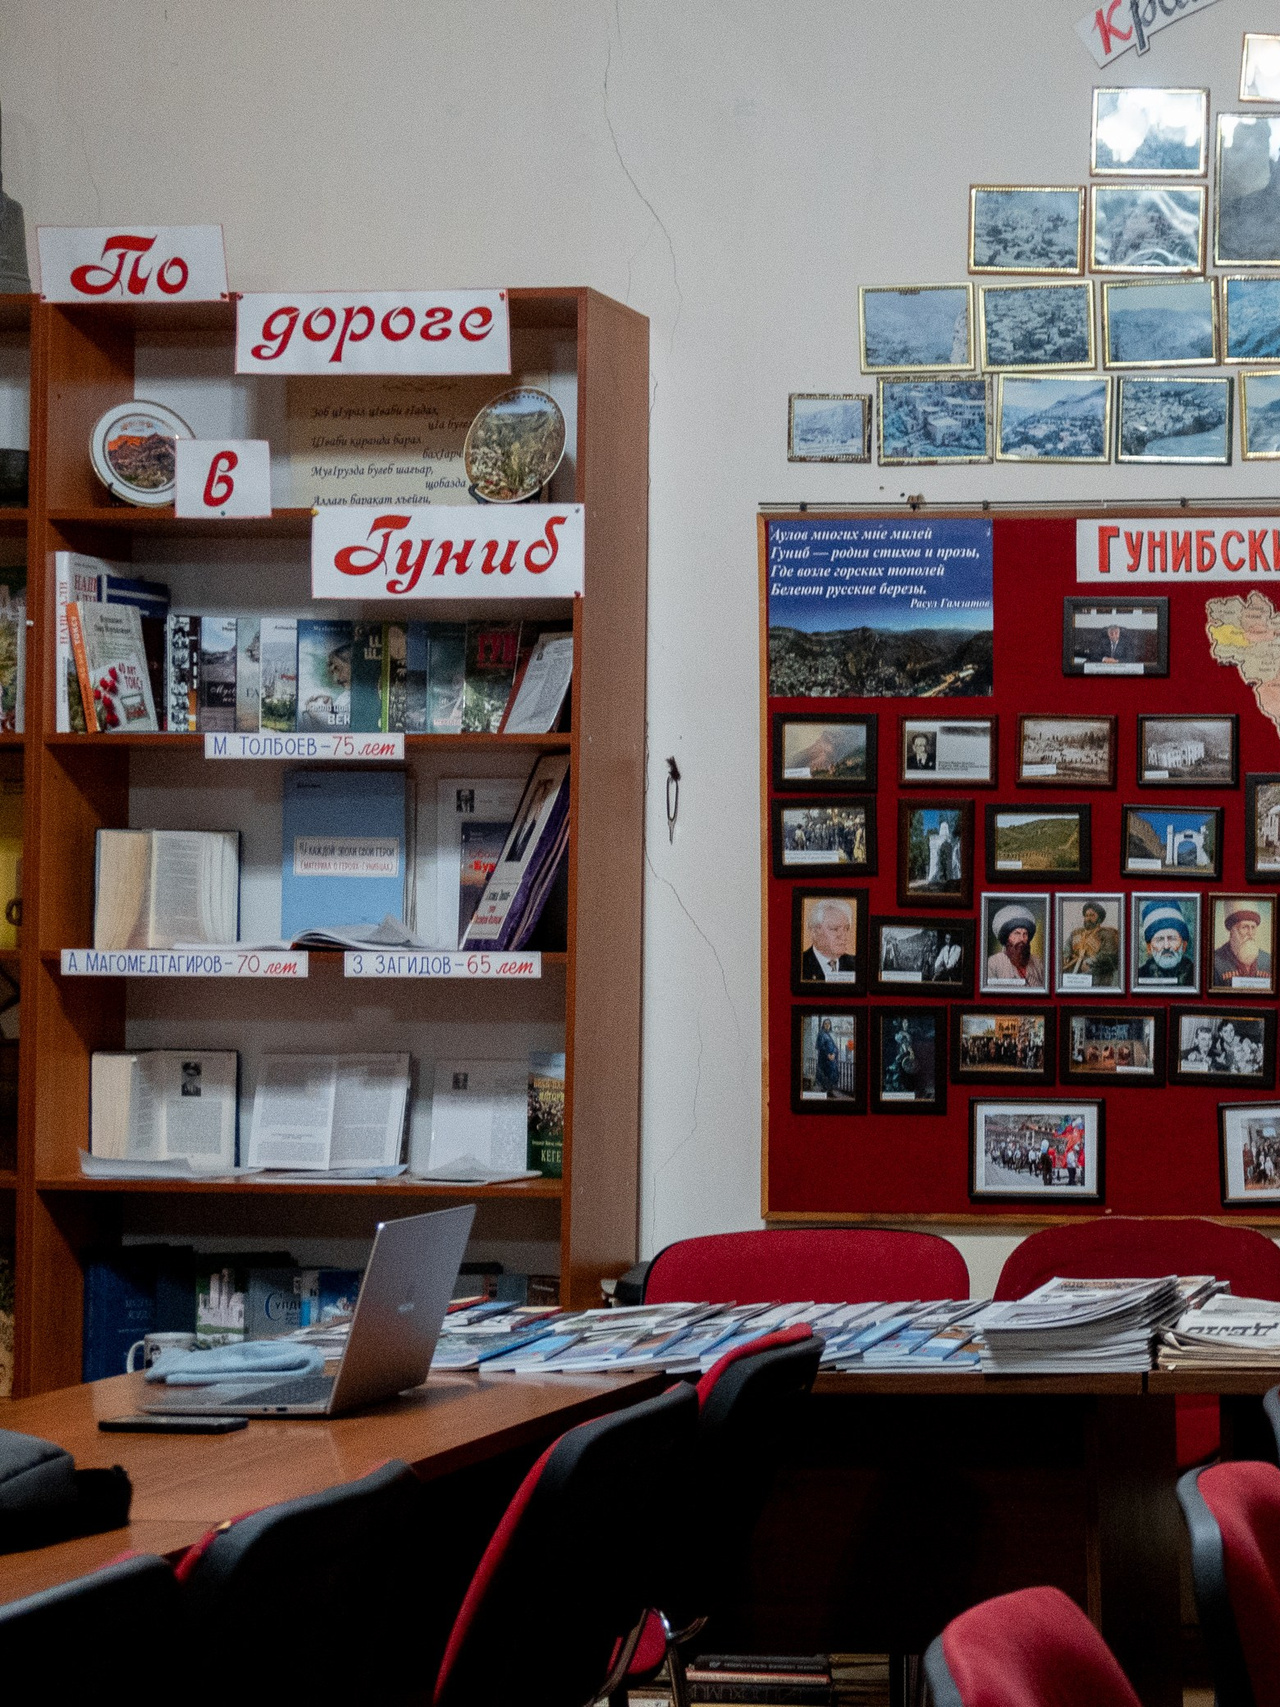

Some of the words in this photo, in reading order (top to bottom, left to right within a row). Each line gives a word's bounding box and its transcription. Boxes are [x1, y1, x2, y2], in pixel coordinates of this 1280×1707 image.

[71, 235, 188, 296] По
[251, 305, 494, 363] дороге
[770, 529, 807, 542] Аулов
[811, 529, 859, 540] многих
[861, 530, 888, 540] мне
[890, 527, 932, 540] милей
[334, 514, 567, 595] Гуниб
[770, 546, 810, 562] Гуниб
[830, 547, 869, 562] родня
[873, 548, 921, 558] стихов
[925, 548, 933, 558] и
[937, 548, 980, 561] прозы,
[770, 565, 793, 578] Где
[797, 567, 831, 577] возле
[834, 567, 885, 579] горских
[888, 564, 945, 579] тополей
[770, 583, 823, 596] Белеют
[826, 586, 876, 598] русские
[879, 583, 927, 598] березы.
[910, 599, 937, 608] Расул
[940, 599, 990, 608] Гамзатов
[213, 736, 231, 755] М.
[68, 955, 81, 972] А.
